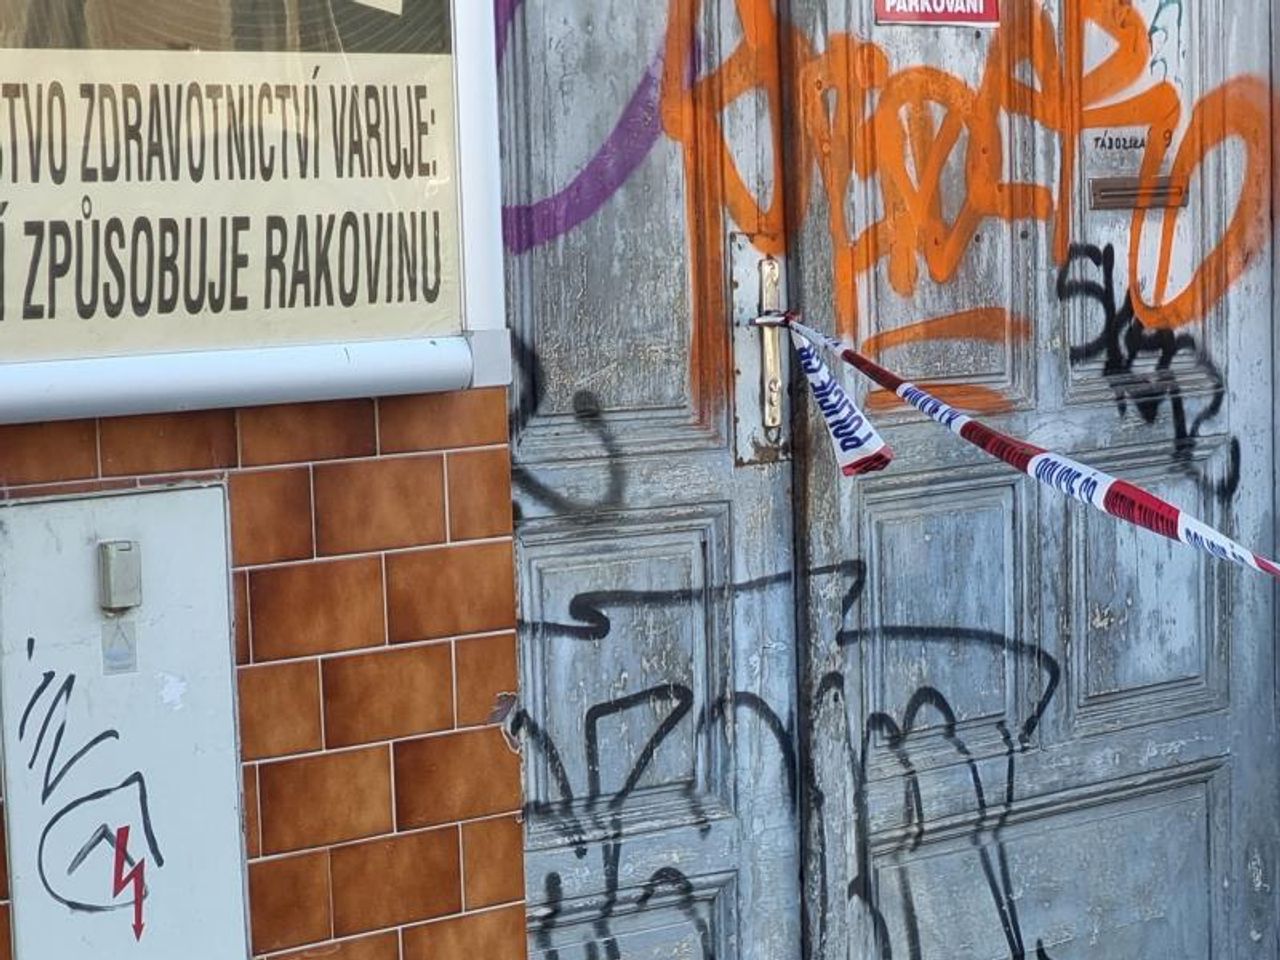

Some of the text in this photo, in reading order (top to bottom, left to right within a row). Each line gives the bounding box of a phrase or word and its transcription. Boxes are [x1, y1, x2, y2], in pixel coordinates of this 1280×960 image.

[0, 67, 438, 185] TVO ZDRAVOTNICTVÍ VARUJE:
[22, 194, 249, 320] ZPŮSOBUJE
[264, 210, 441, 309] RAKOVINU
